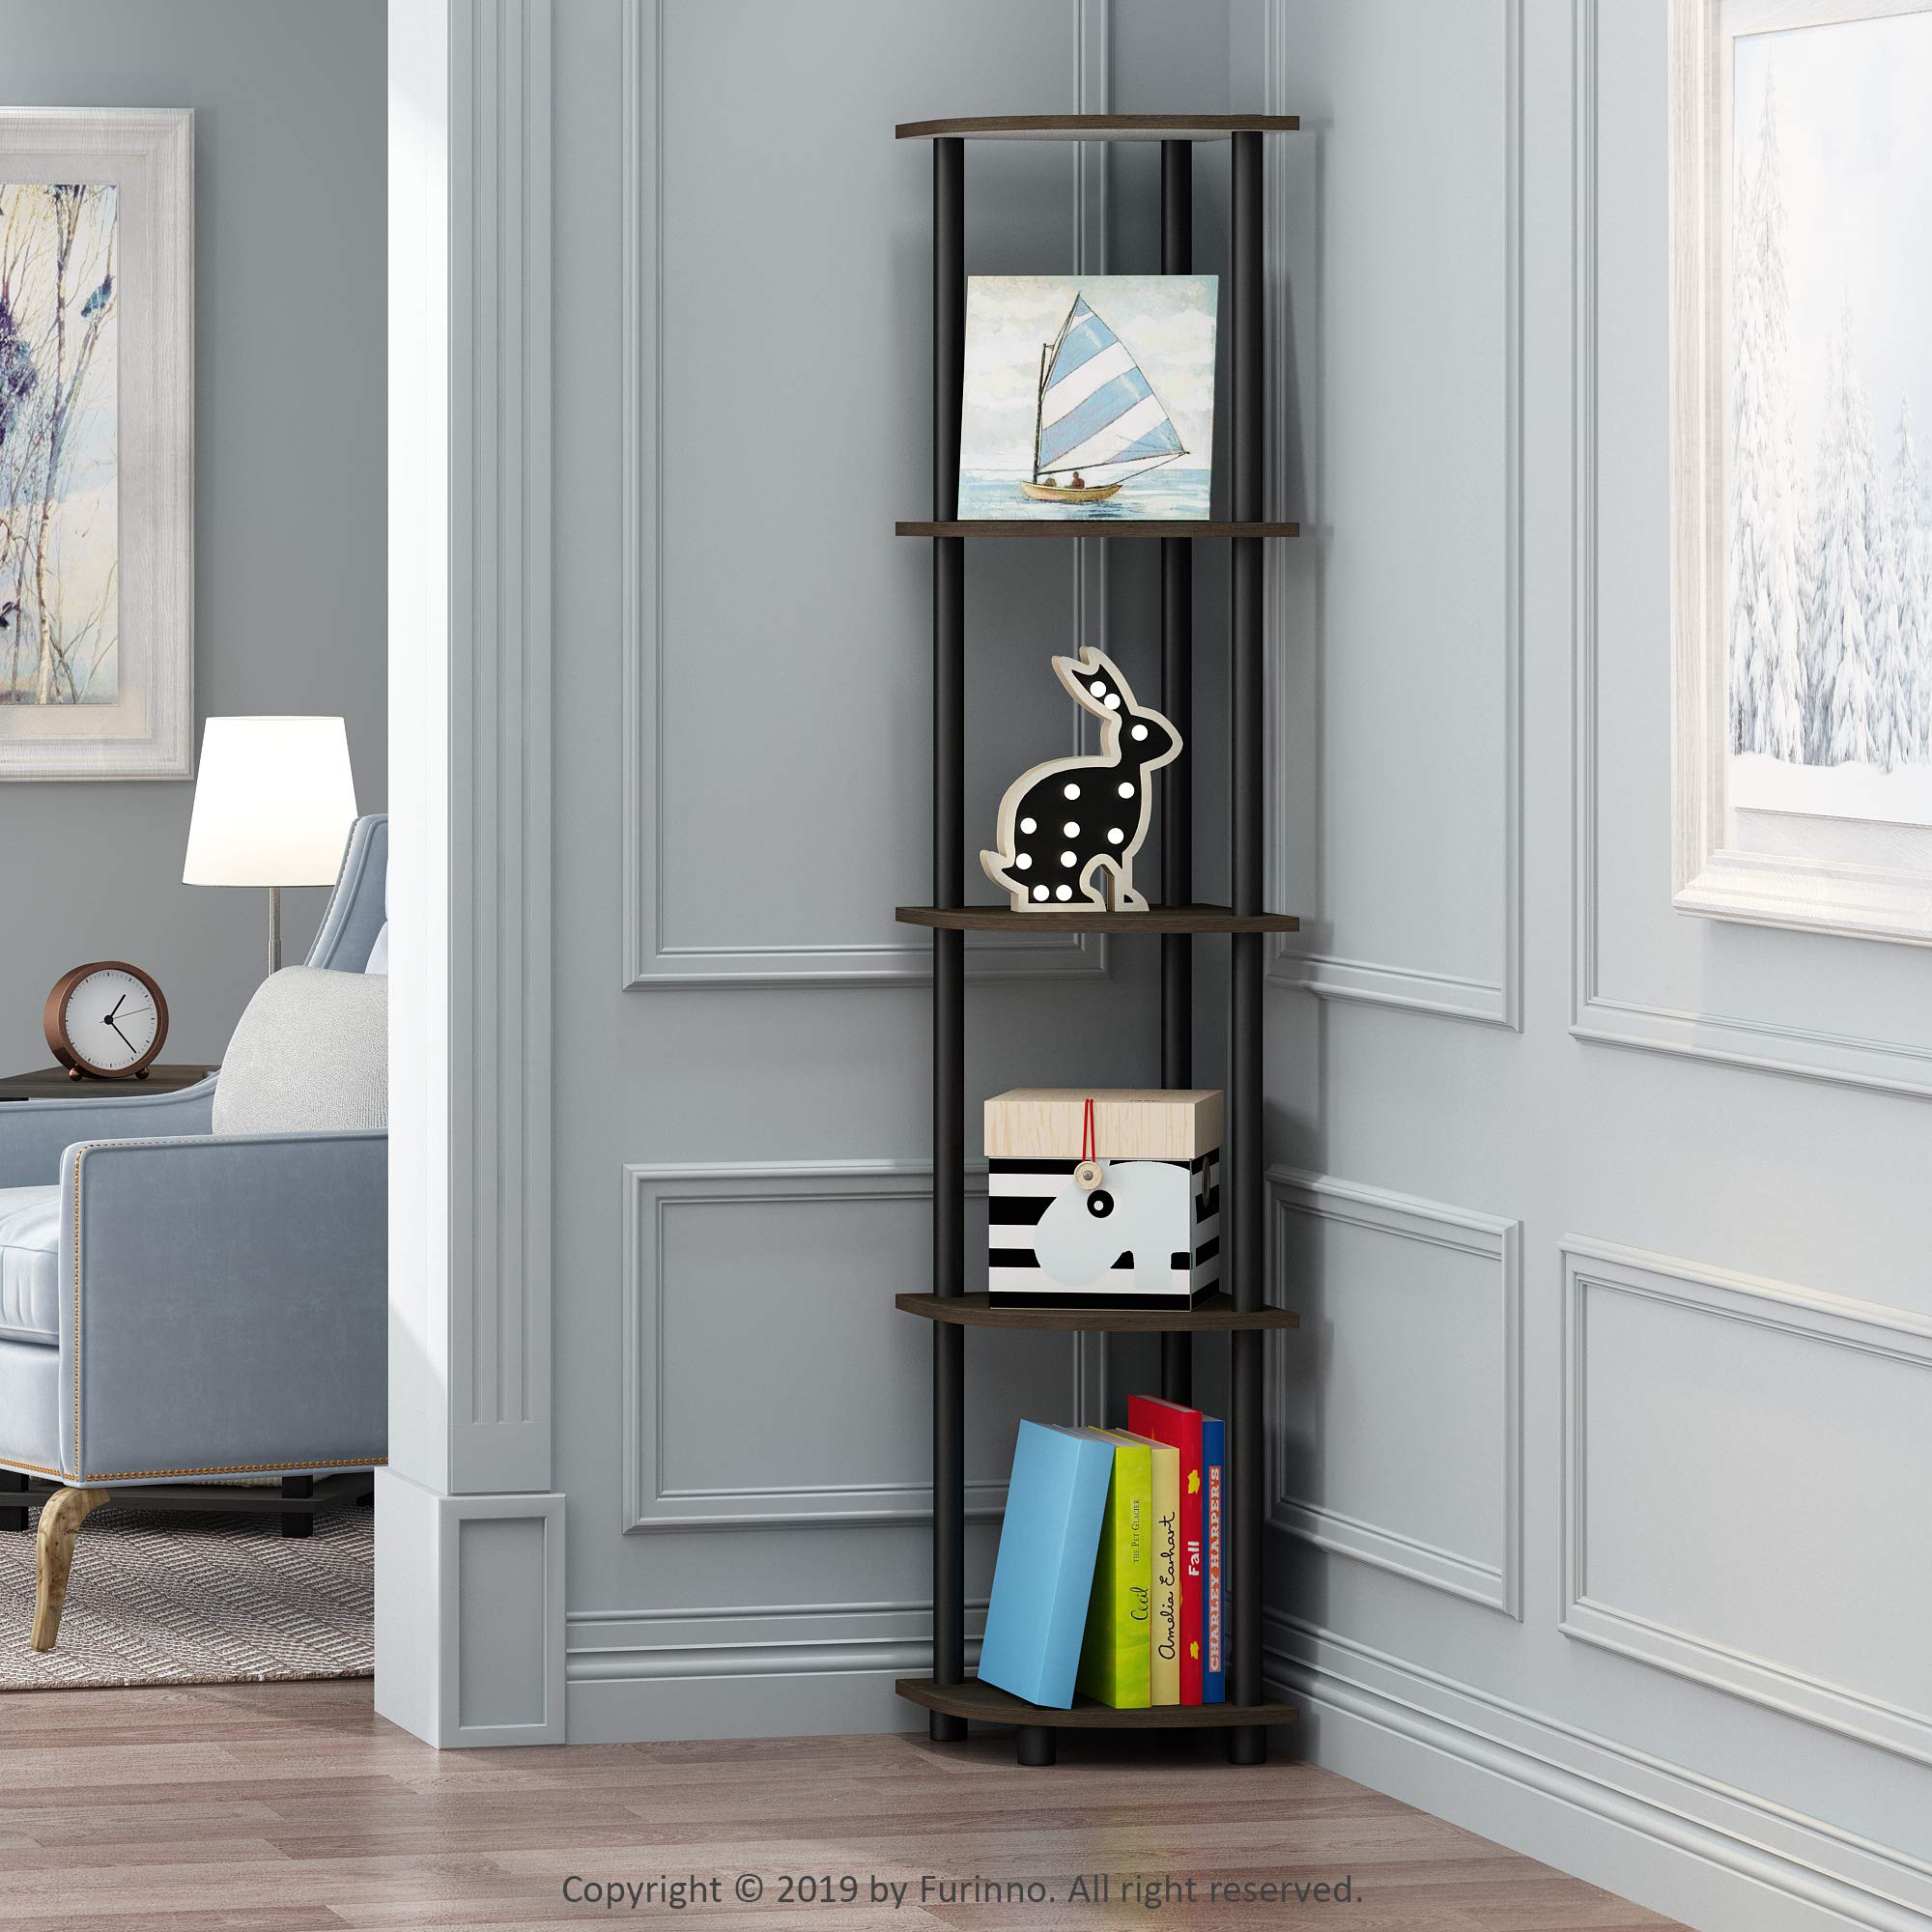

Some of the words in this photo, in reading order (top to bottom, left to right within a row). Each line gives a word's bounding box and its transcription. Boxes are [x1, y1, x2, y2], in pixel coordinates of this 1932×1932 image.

[1131, 1499, 1140, 1531] GLACIER
[1131, 1533, 1140, 1548] PET
[1210, 1467, 1220, 1569] HARPER'S
[1159, 1511, 1176, 1586] Earhart
[1188, 1541, 1200, 1577] Fall
[1130, 1586, 1149, 1621] Cecil
[1158, 1591, 1175, 1660] Amelia
[1210, 1574, 1220, 1670] CHARLEY
